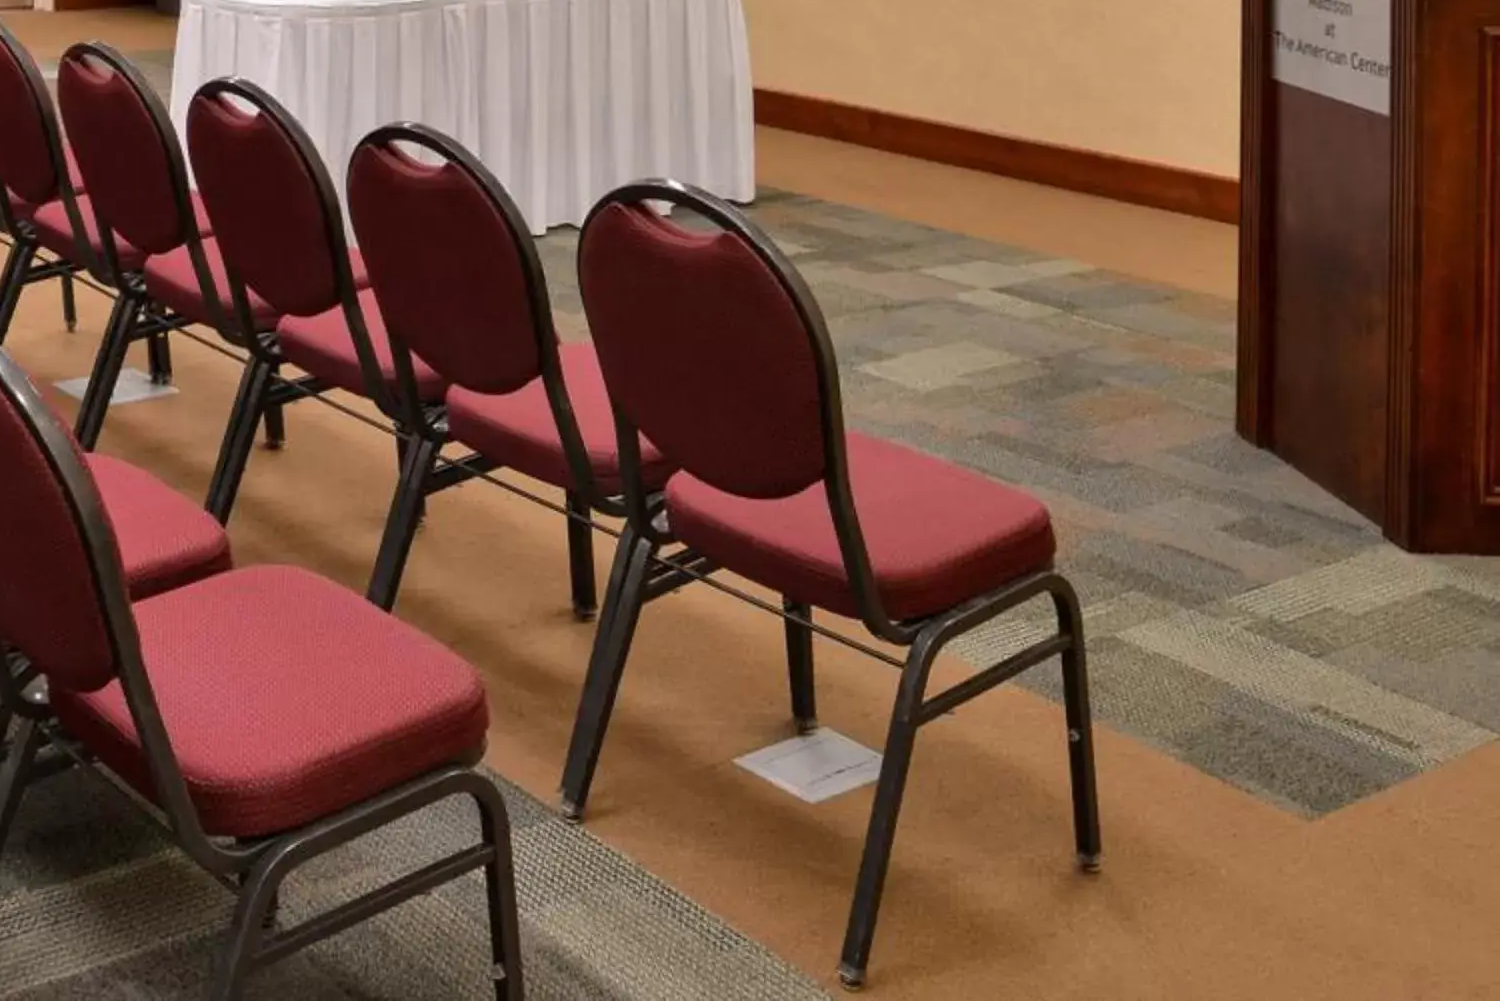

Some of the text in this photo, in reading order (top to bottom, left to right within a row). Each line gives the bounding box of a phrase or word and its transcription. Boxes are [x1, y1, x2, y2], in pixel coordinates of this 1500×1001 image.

[1324, 22, 1336, 39] at
[1275, 30, 1392, 77] The American Center
